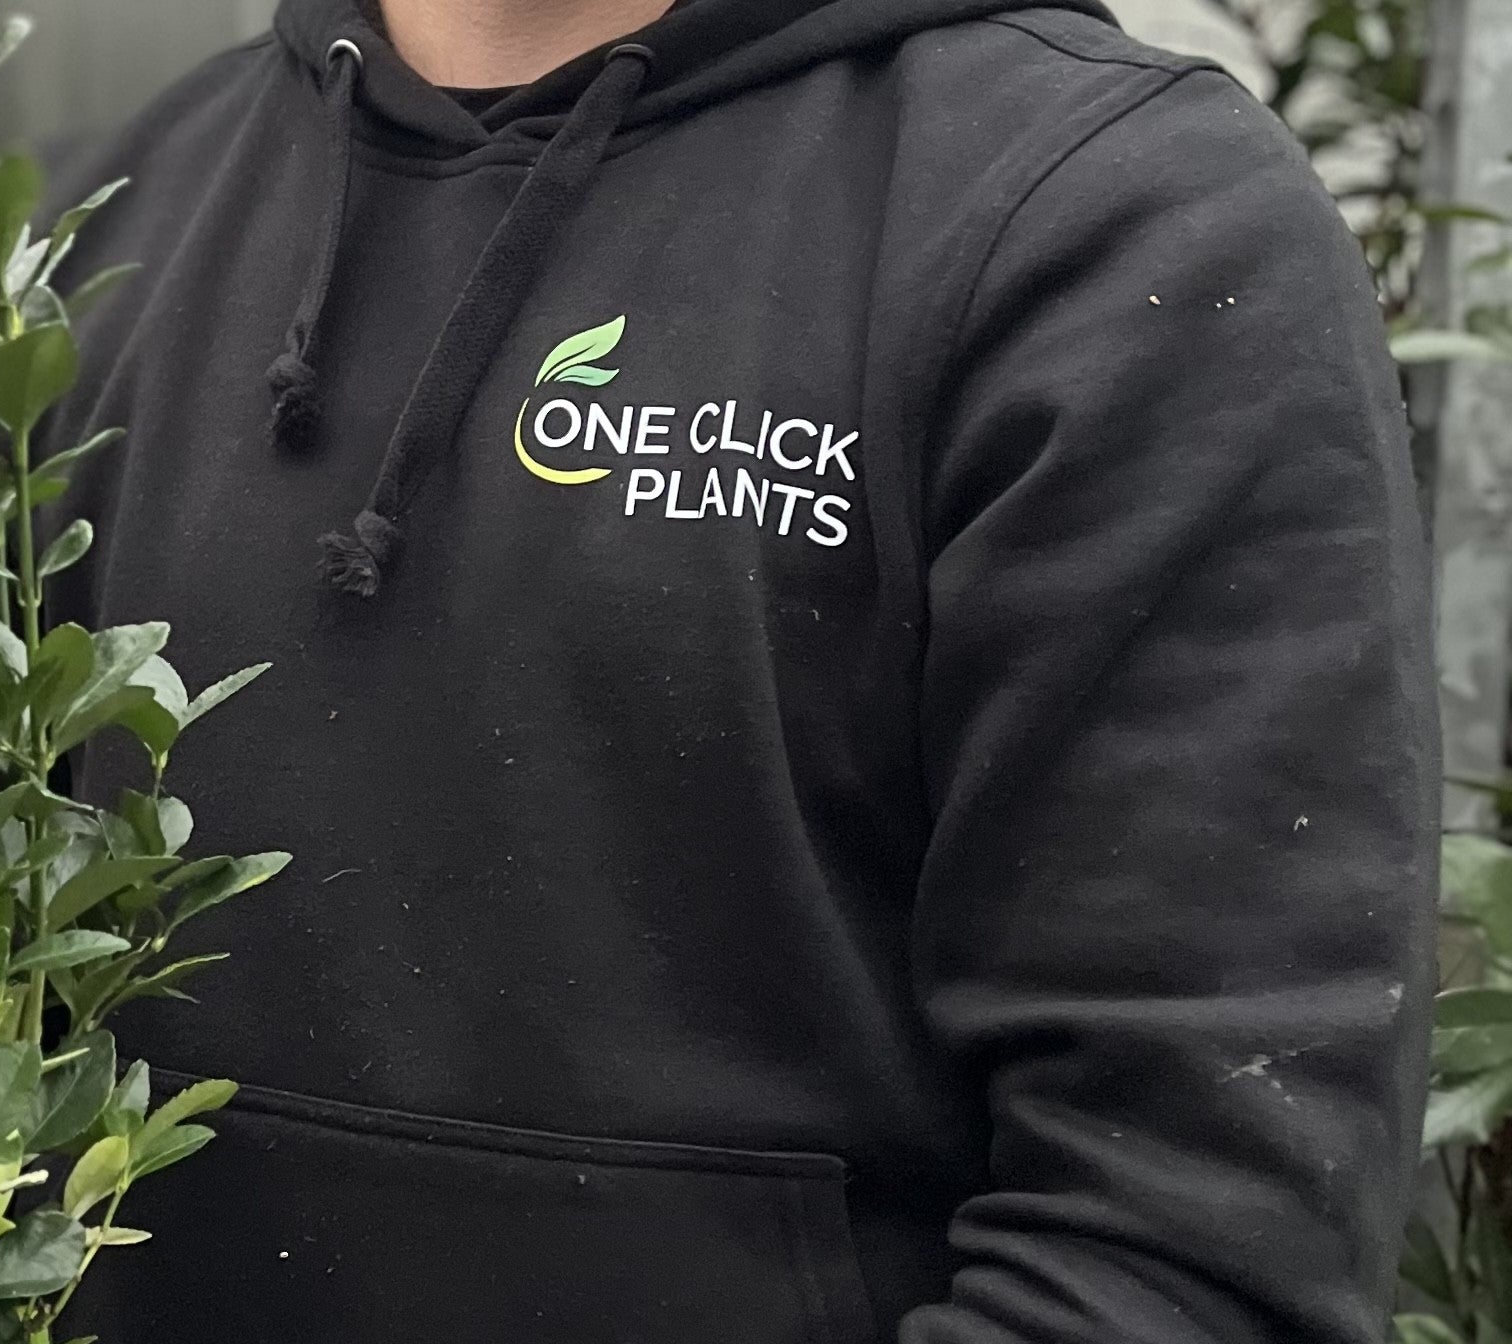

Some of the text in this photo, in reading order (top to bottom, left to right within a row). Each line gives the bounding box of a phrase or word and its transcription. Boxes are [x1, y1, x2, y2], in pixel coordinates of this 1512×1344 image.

[533, 398, 859, 481] ONE CLICK
[624, 467, 851, 547] PLANTS
